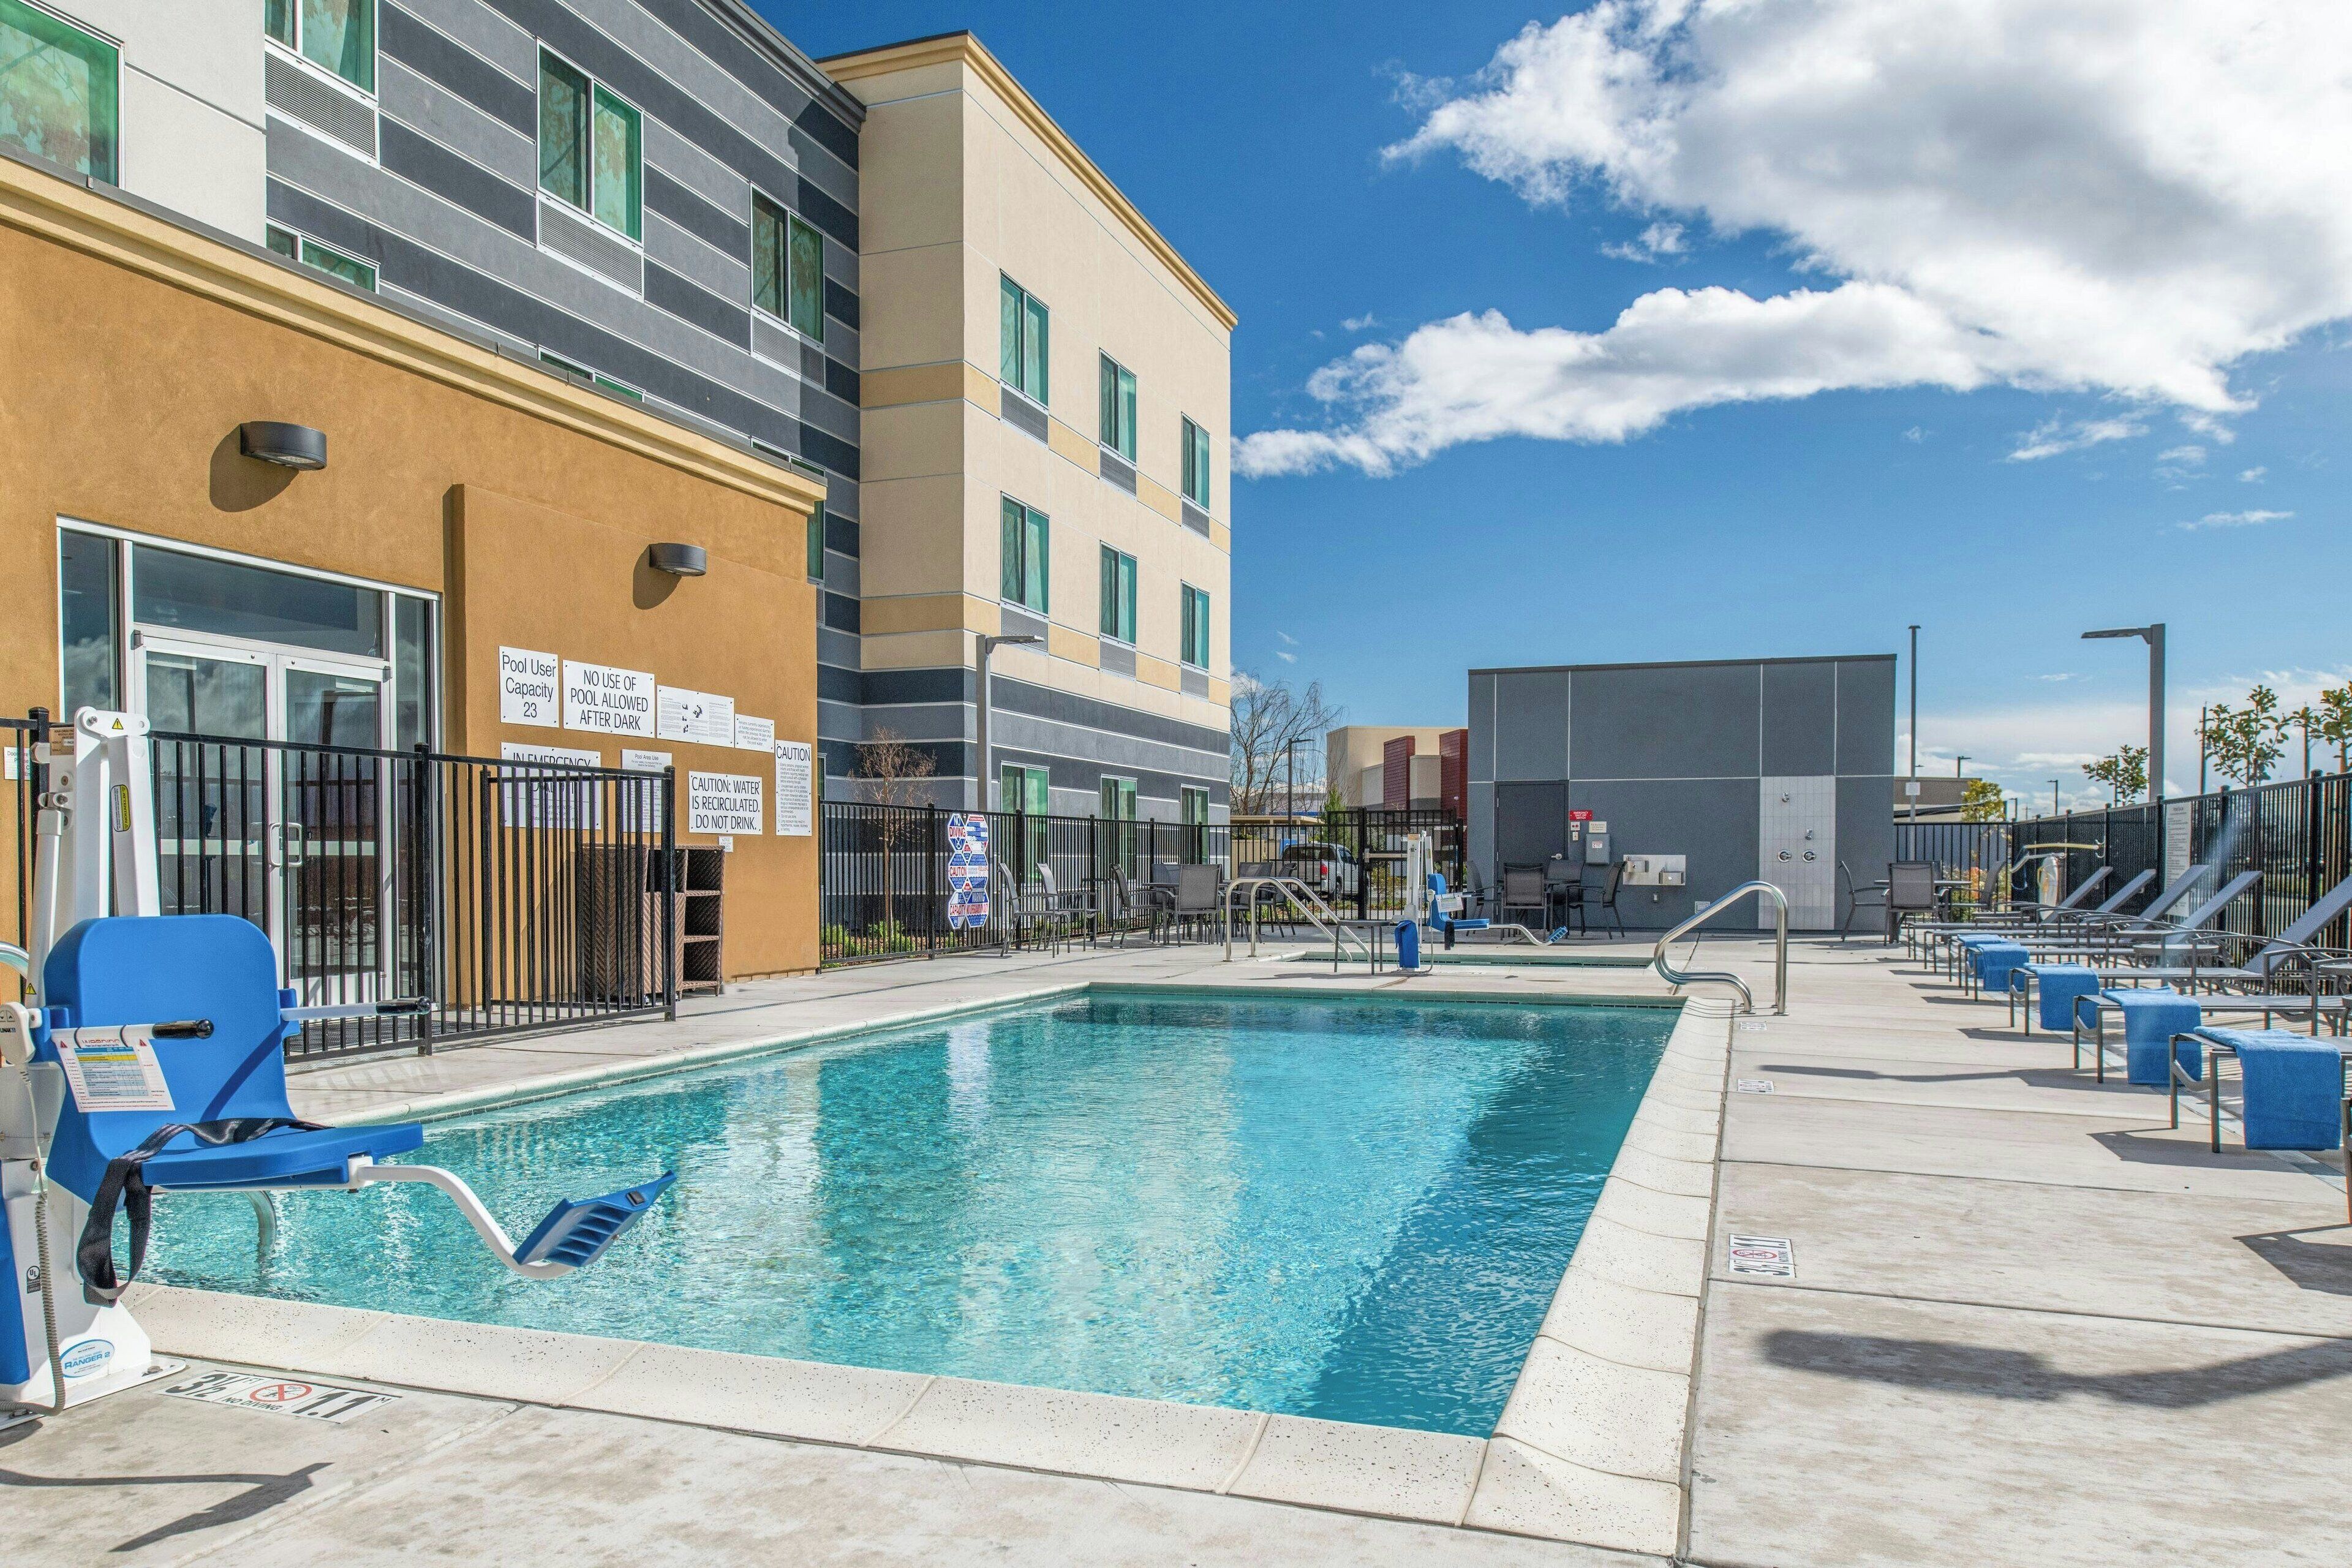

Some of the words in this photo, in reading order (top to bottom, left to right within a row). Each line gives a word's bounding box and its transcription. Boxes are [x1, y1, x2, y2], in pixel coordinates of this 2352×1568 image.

[502, 655, 527, 673] Pool
[531, 659, 556, 677] User
[584, 669, 599, 686] NO
[603, 673, 620, 689] USE
[624, 676, 636, 691] OF
[506, 677, 554, 702] Capacity
[571, 688, 598, 706] POOL
[601, 693, 648, 712] ALLOWED
[523, 702, 537, 718] 23
[579, 709, 611, 728] AFTER
[614, 713, 641, 730] DARK
[776, 745, 810, 761] CAUTION
[692, 777, 731, 793] CAUTION:
[733, 780, 760, 794] WATER
[692, 795, 699, 809] IS
[702, 796, 760, 813] RECIRCULATED.
[696, 814, 709, 828] DO
[711, 815, 728, 829] NOT
[731, 816, 756, 830] DRINK.
[954, 815, 961, 826] NO
[949, 827, 966, 837] DIVING
[949, 867, 967, 876] CAUTION
[64, 1354, 102, 1369] RANGER
[240, 1399, 282, 1410] DIVING
[292, 1392, 378, 1418] 1.1
